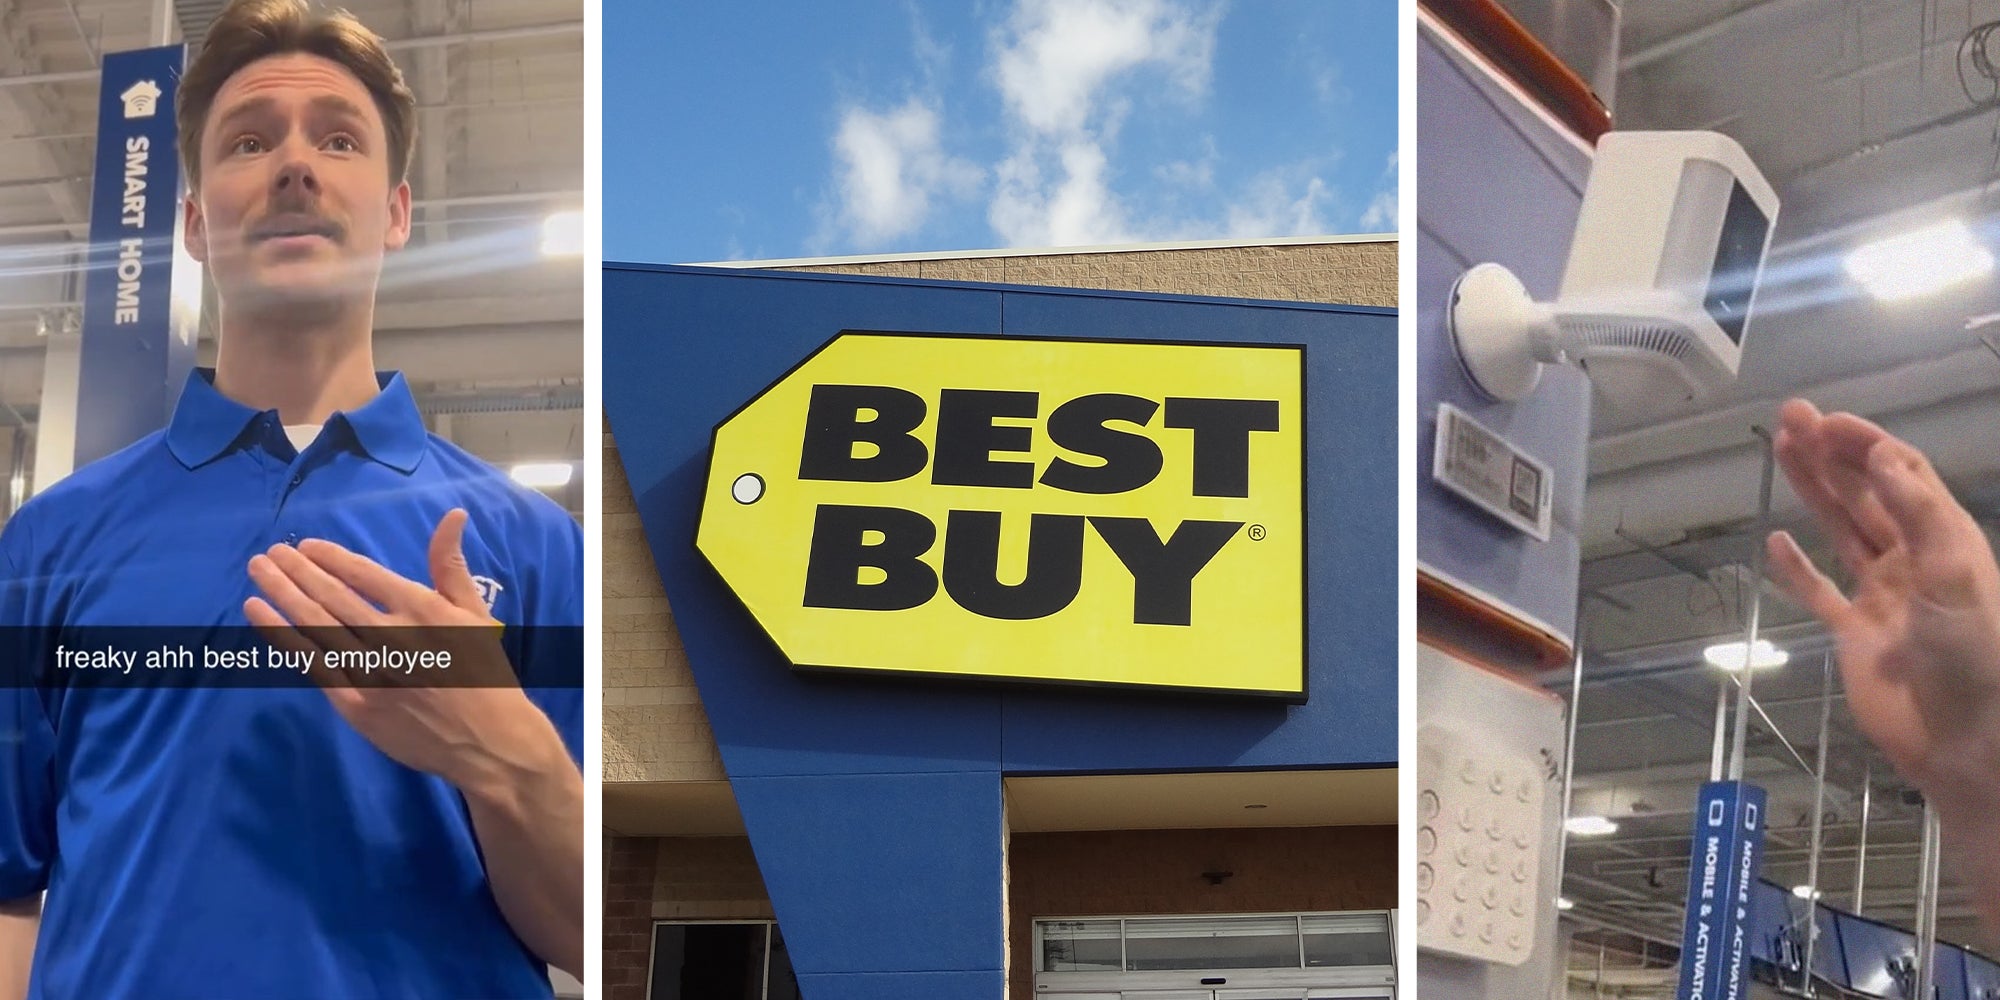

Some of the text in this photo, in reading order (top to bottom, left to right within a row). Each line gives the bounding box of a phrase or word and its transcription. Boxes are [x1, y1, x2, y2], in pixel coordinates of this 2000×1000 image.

[114, 136, 150, 325] SMART HOME
[798, 384, 1280, 499] BEST
[802, 503, 1247, 627] BUY
[1700, 903, 1713, 917] &
[1702, 836, 1719, 899] MOBILE
[1738, 840, 1753, 903] MOBILE
